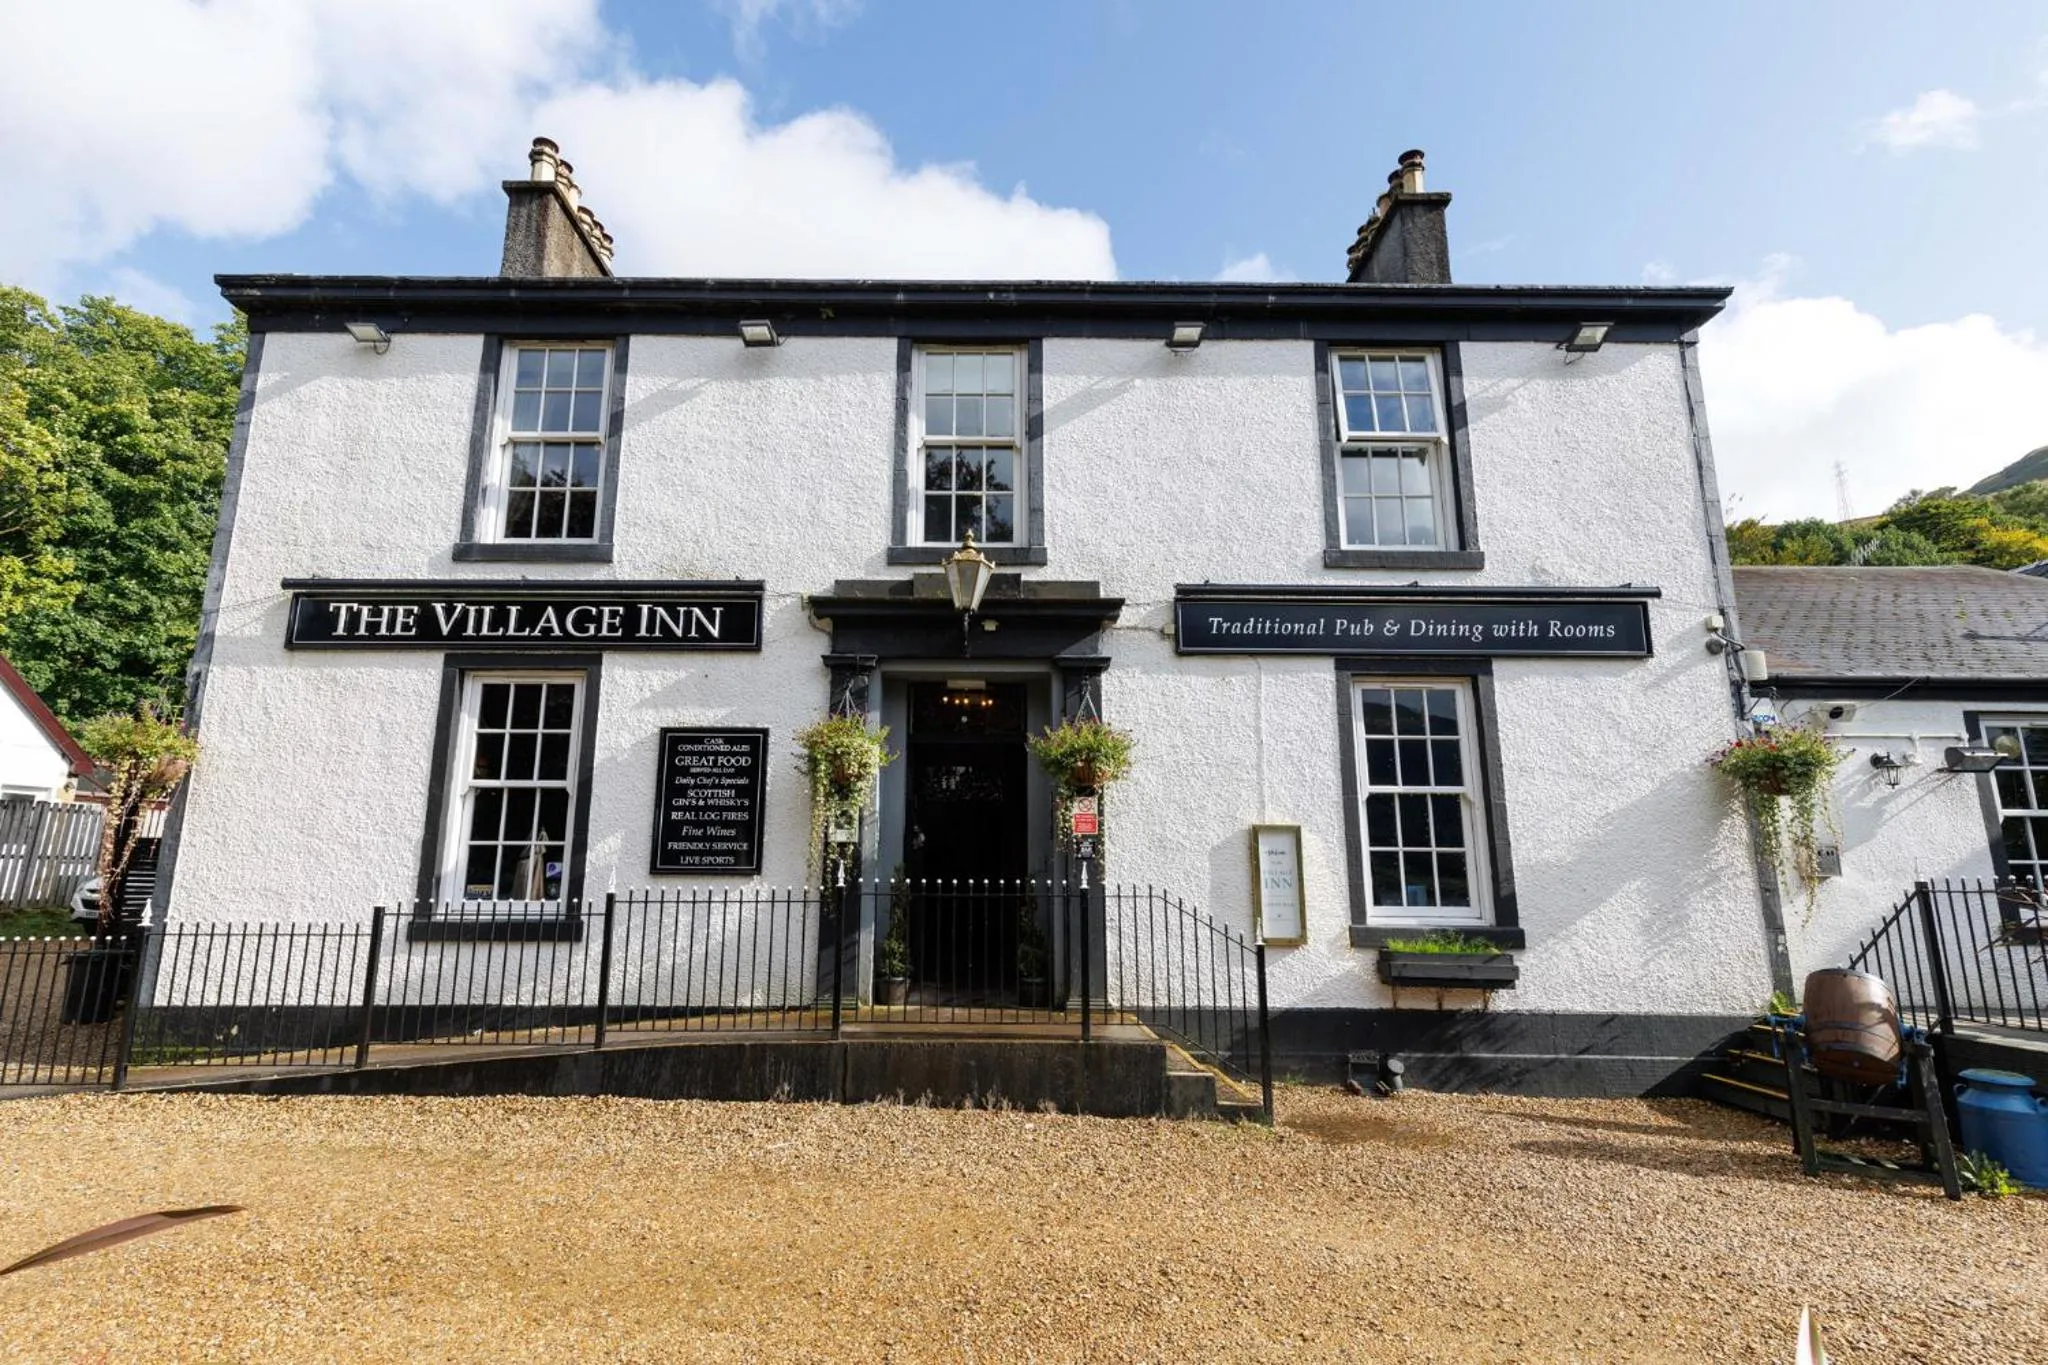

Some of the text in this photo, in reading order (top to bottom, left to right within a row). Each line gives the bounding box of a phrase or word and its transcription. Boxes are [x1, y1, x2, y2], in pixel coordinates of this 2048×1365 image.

[329, 602, 725, 639] THE VILLAGE INN
[1207, 617, 1617, 642] Traditional Pub & Dining with Rooms
[675, 756, 751, 766] GREAT FOOD
[675, 776, 749, 786] Daily Chef's Specials
[687, 789, 735, 797] SCOTTISH
[672, 798, 750, 806] GIN'S & WHISKY'S
[671, 811, 750, 820] REAL LOG FIRES
[682, 826, 737, 836] Fine Wines
[667, 842, 748, 850] FRIENDLY SERVICE
[680, 856, 735, 864] LIVE SPORTS
[1264, 877, 1293, 889] INN
